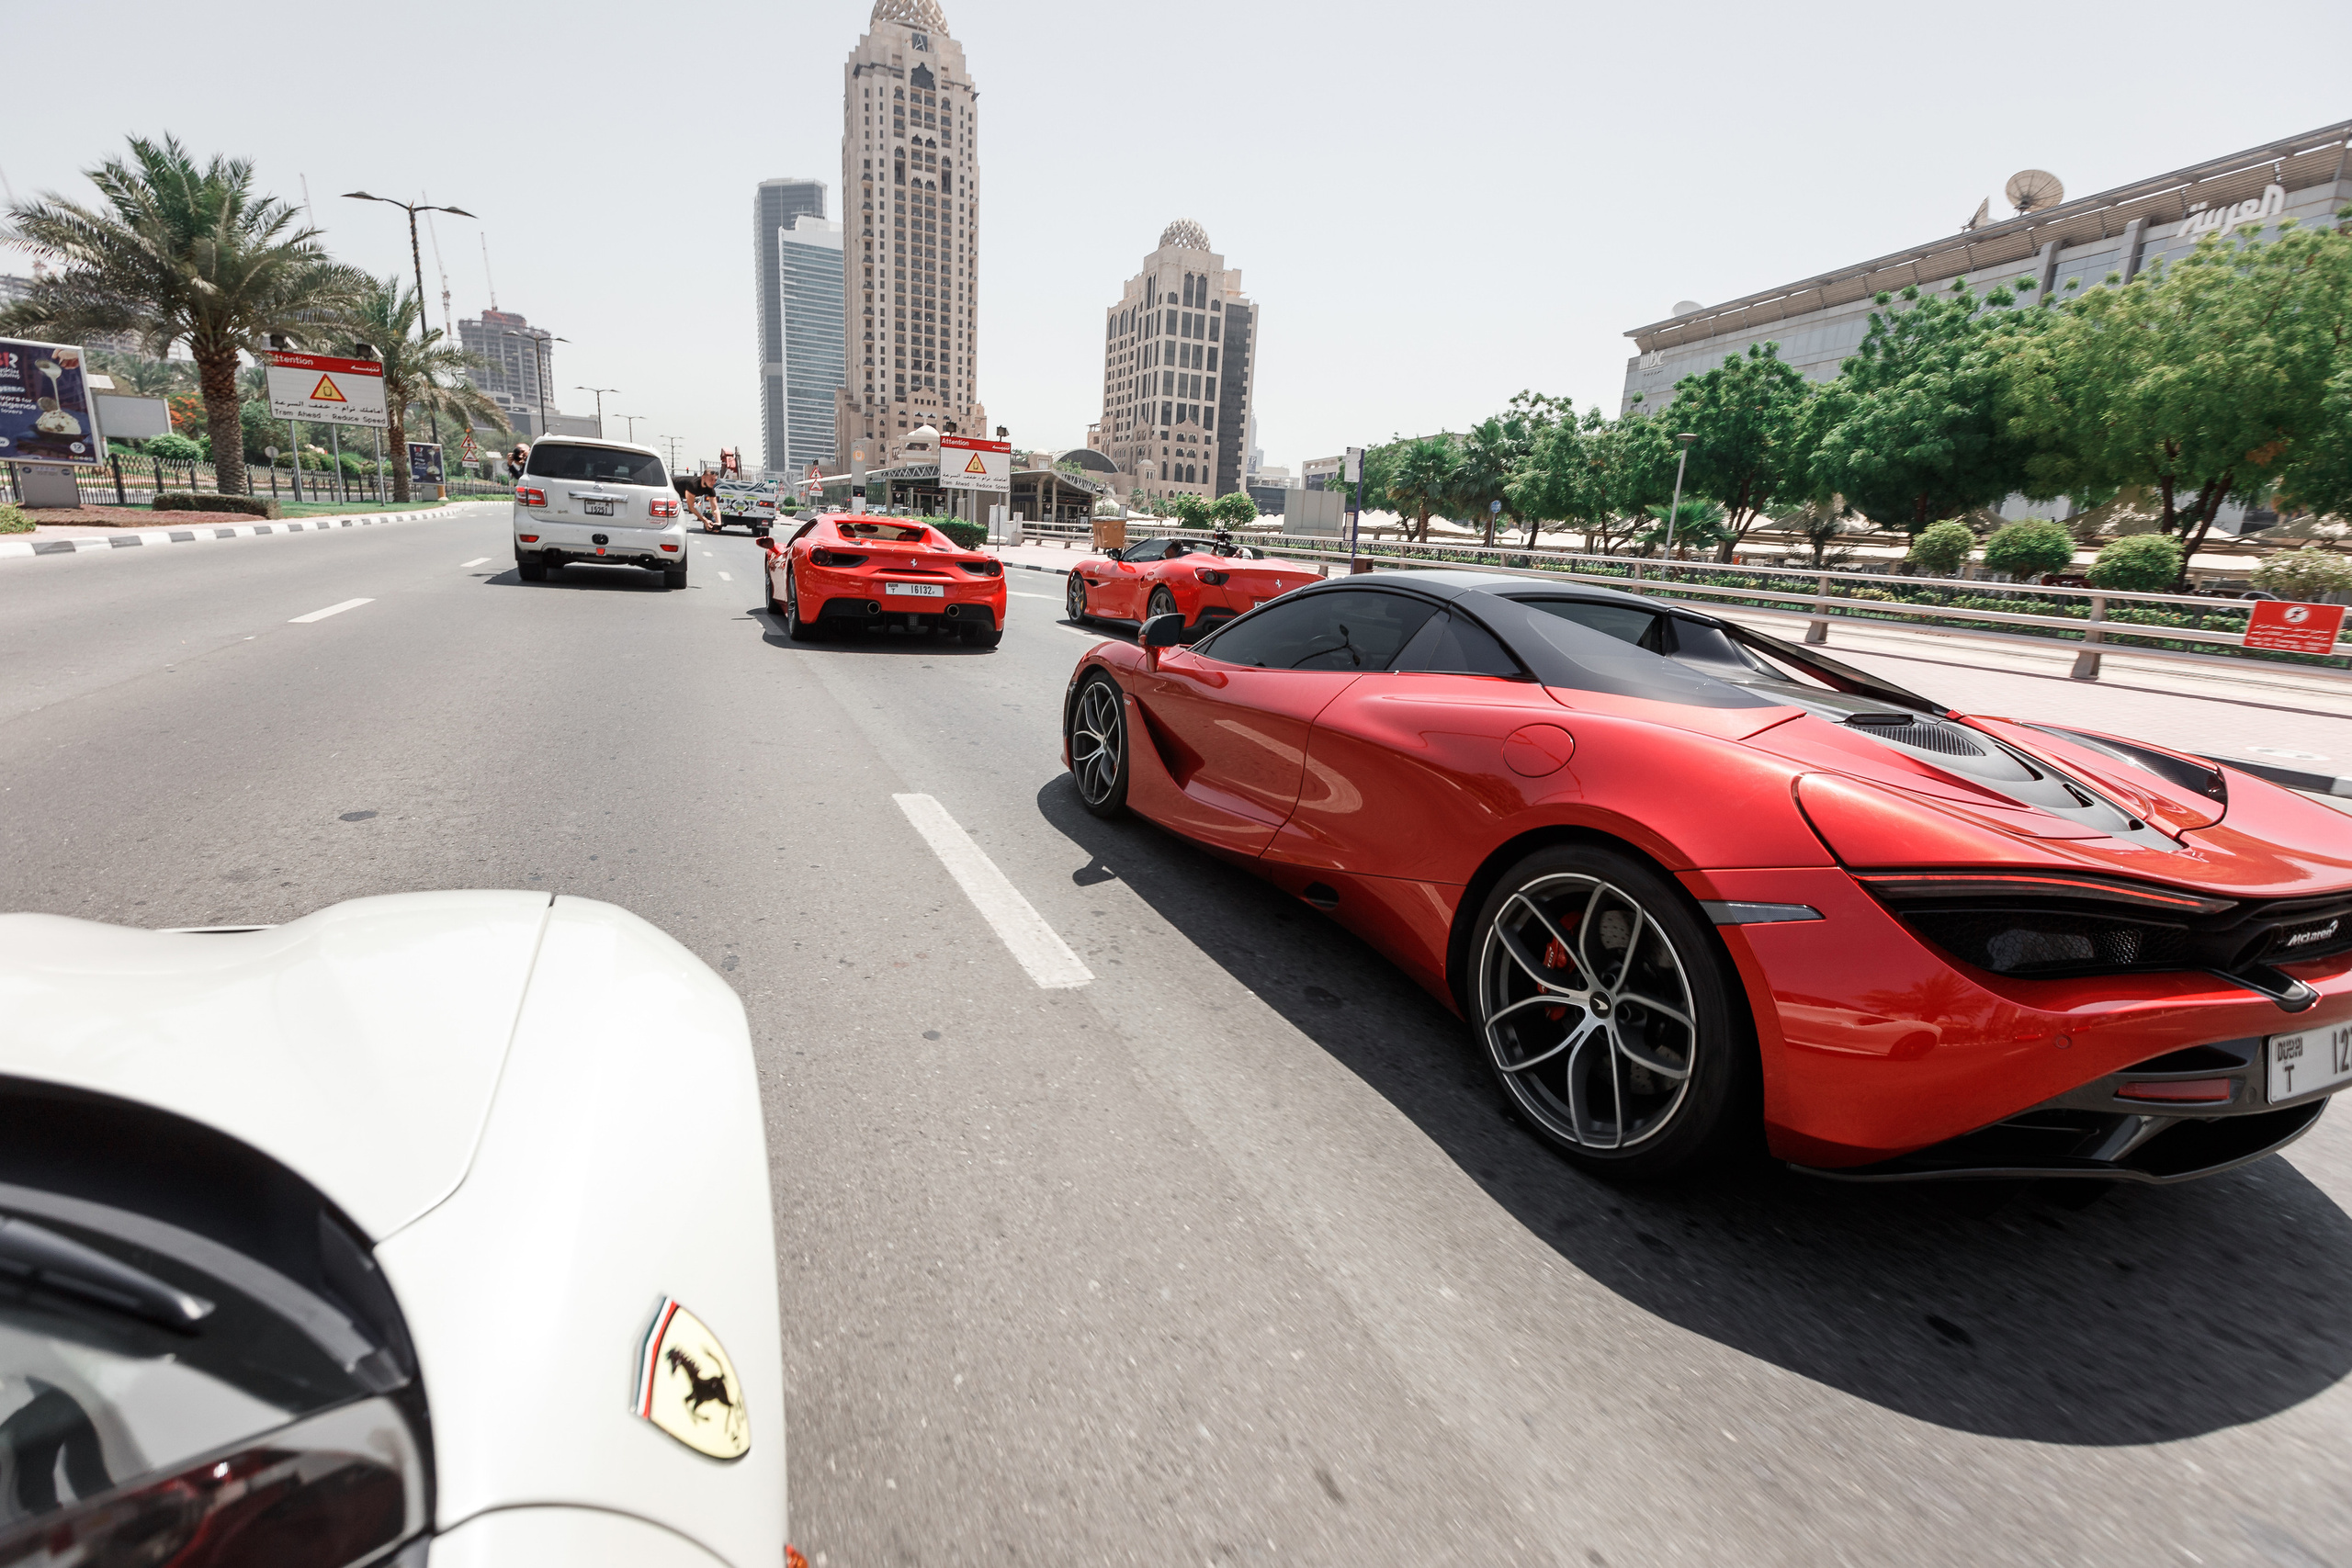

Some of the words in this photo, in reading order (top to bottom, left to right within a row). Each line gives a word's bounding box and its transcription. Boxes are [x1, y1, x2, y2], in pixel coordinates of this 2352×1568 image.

[2176, 184, 2286, 244] العربية
[1639, 349, 1666, 369] mbc
[275, 408, 294, 416] Tram
[298, 411, 322, 419] Ahead
[332, 412, 359, 423] Reduce
[363, 415, 386, 424] Speed
[941, 437, 970, 447] Attention
[910, 584, 933, 595] 16132
[2287, 928, 2334, 947] McLaren
[2284, 1065, 2295, 1093] T
